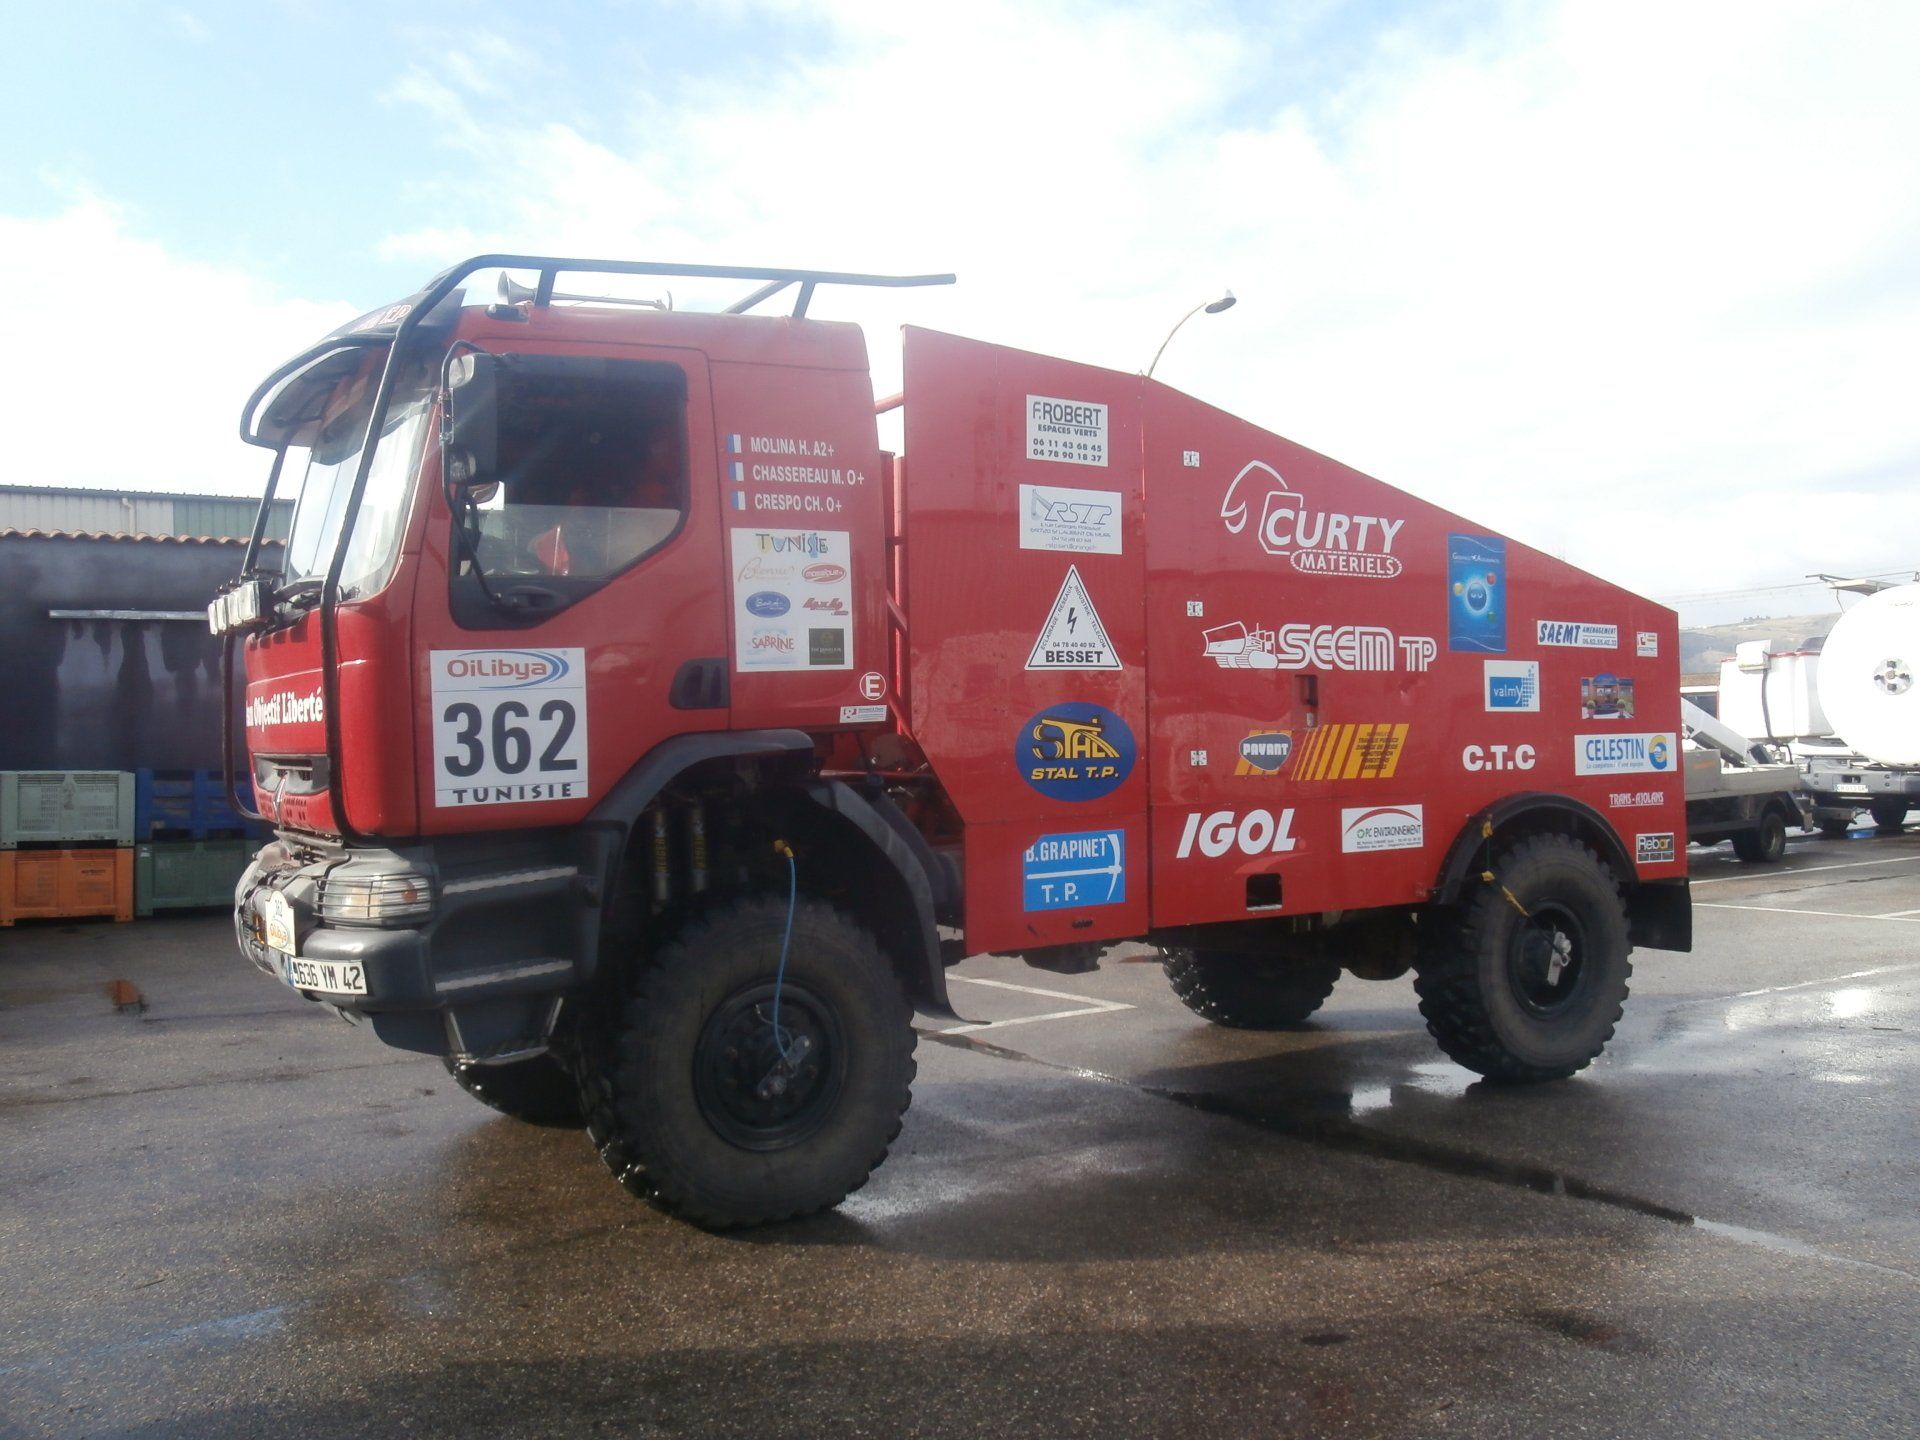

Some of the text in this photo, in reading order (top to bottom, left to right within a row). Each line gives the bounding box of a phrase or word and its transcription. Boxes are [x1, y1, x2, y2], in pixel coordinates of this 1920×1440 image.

[1038, 424, 1098, 438] ESPACES VERTS
[751, 437, 834, 456] MOLINA H. A2+
[1033, 438, 1045, 446] 06
[1049, 440, 1058, 448] 11
[1062, 441, 1073, 449] 43
[1091, 445, 1102, 453] 45
[1033, 448, 1045, 456] 04
[1048, 450, 1059, 458] 78
[1062, 451, 1073, 459] 90
[1078, 453, 1088, 461] 18
[752, 465, 829, 484] CHASSEREAU
[831, 470, 844, 485] M.
[754, 494, 801, 511] CRESPO
[804, 496, 824, 512] CH.
[1266, 508, 1405, 553] CURTY
[1300, 554, 1394, 574] MATERIELS
[1041, 585, 1073, 650] ECLAIRAGE RESEAUX
[1075, 585, 1106, 648] INDUSTRIE TELECOM
[1539, 623, 1581, 644] SAEMT
[1046, 650, 1103, 663] BESSET
[1277, 623, 1437, 672] SEEM TP
[447, 659, 547, 680] OiLibya
[865, 675, 881, 697] E
[1494, 680, 1523, 704] valmy
[253, 695, 281, 733] Objectif
[282, 686, 323, 724] Liberté
[444, 699, 578, 777] 362
[1462, 744, 1536, 771] C.T.C
[1586, 738, 1644, 761] CELESTIN
[1031, 766, 1119, 780] STAL T.P.
[453, 783, 572, 804] TUNISIE
[1176, 808, 1296, 859] IGOL
[1373, 824, 1422, 838] ENVIRONNEMENT
[1026, 838, 1107, 862] B.GRAPINET
[1638, 836, 1671, 850] Rebar
[293, 964, 363, 990] 9636 YM 42
